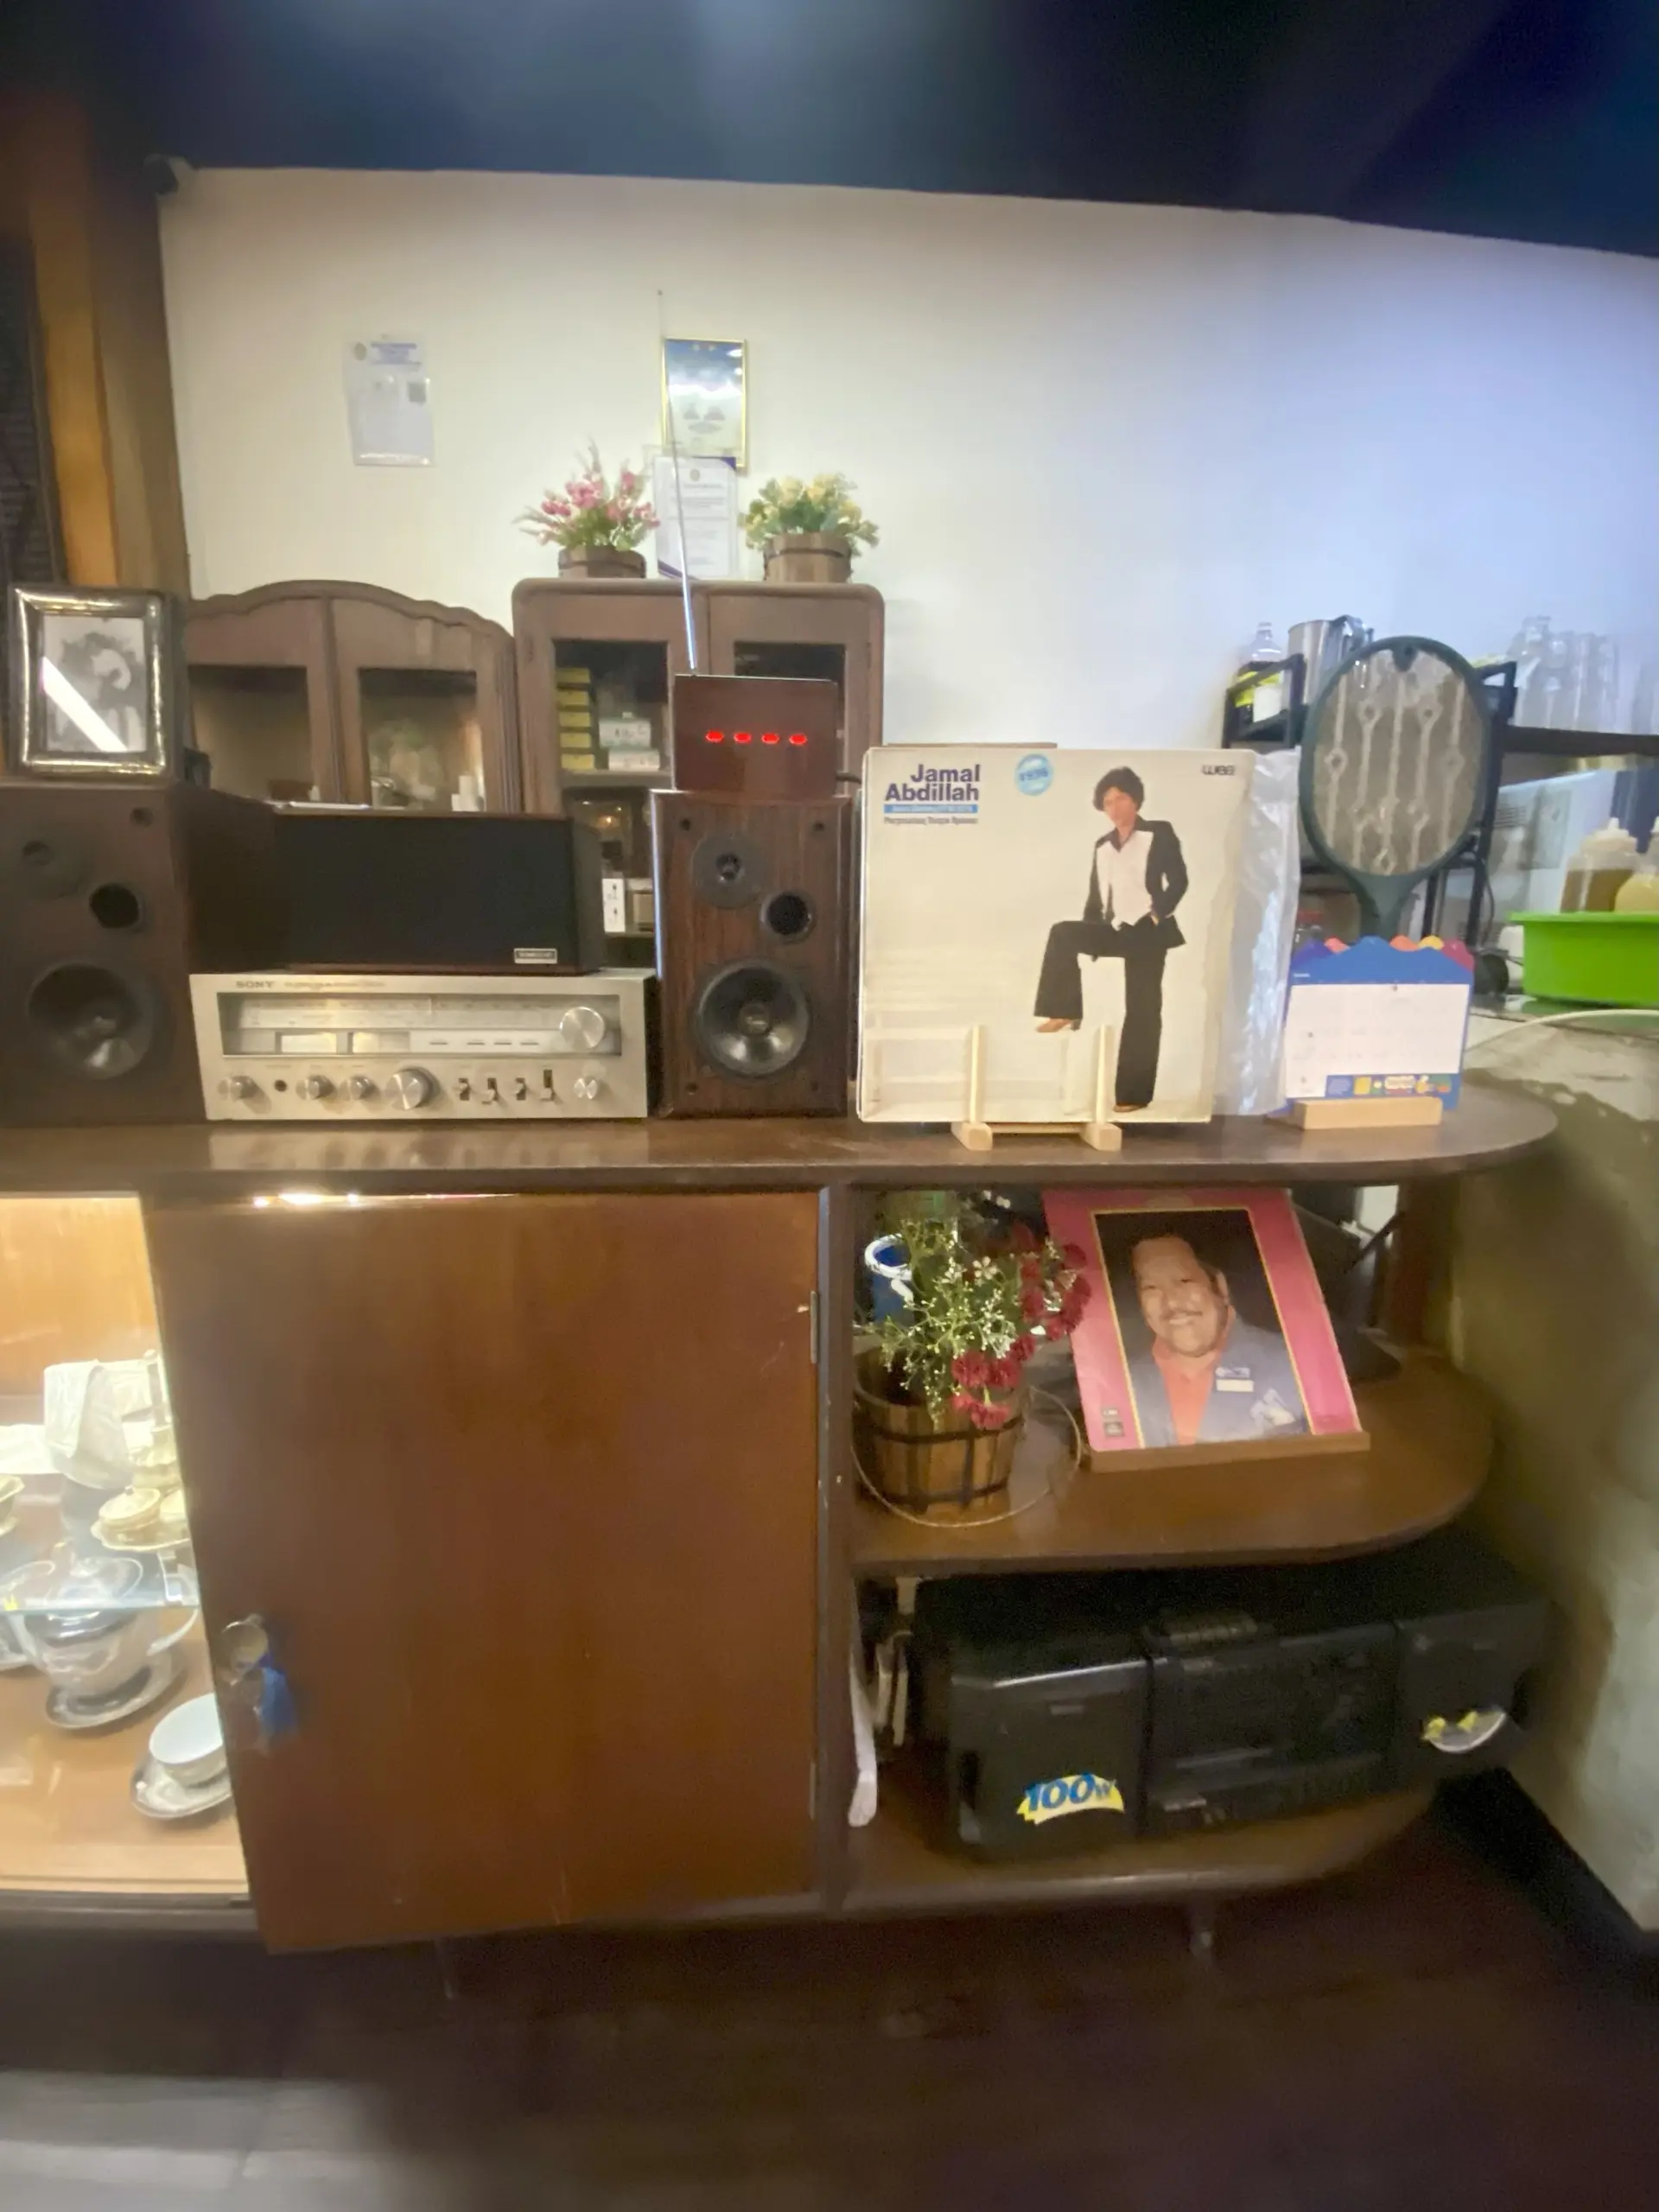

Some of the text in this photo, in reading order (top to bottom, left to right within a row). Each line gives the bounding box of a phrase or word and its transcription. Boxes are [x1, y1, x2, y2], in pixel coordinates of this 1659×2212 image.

[910, 764, 981, 783] Jamal
[884, 783, 980, 802] Abdillah
[236, 980, 275, 989] SONY
